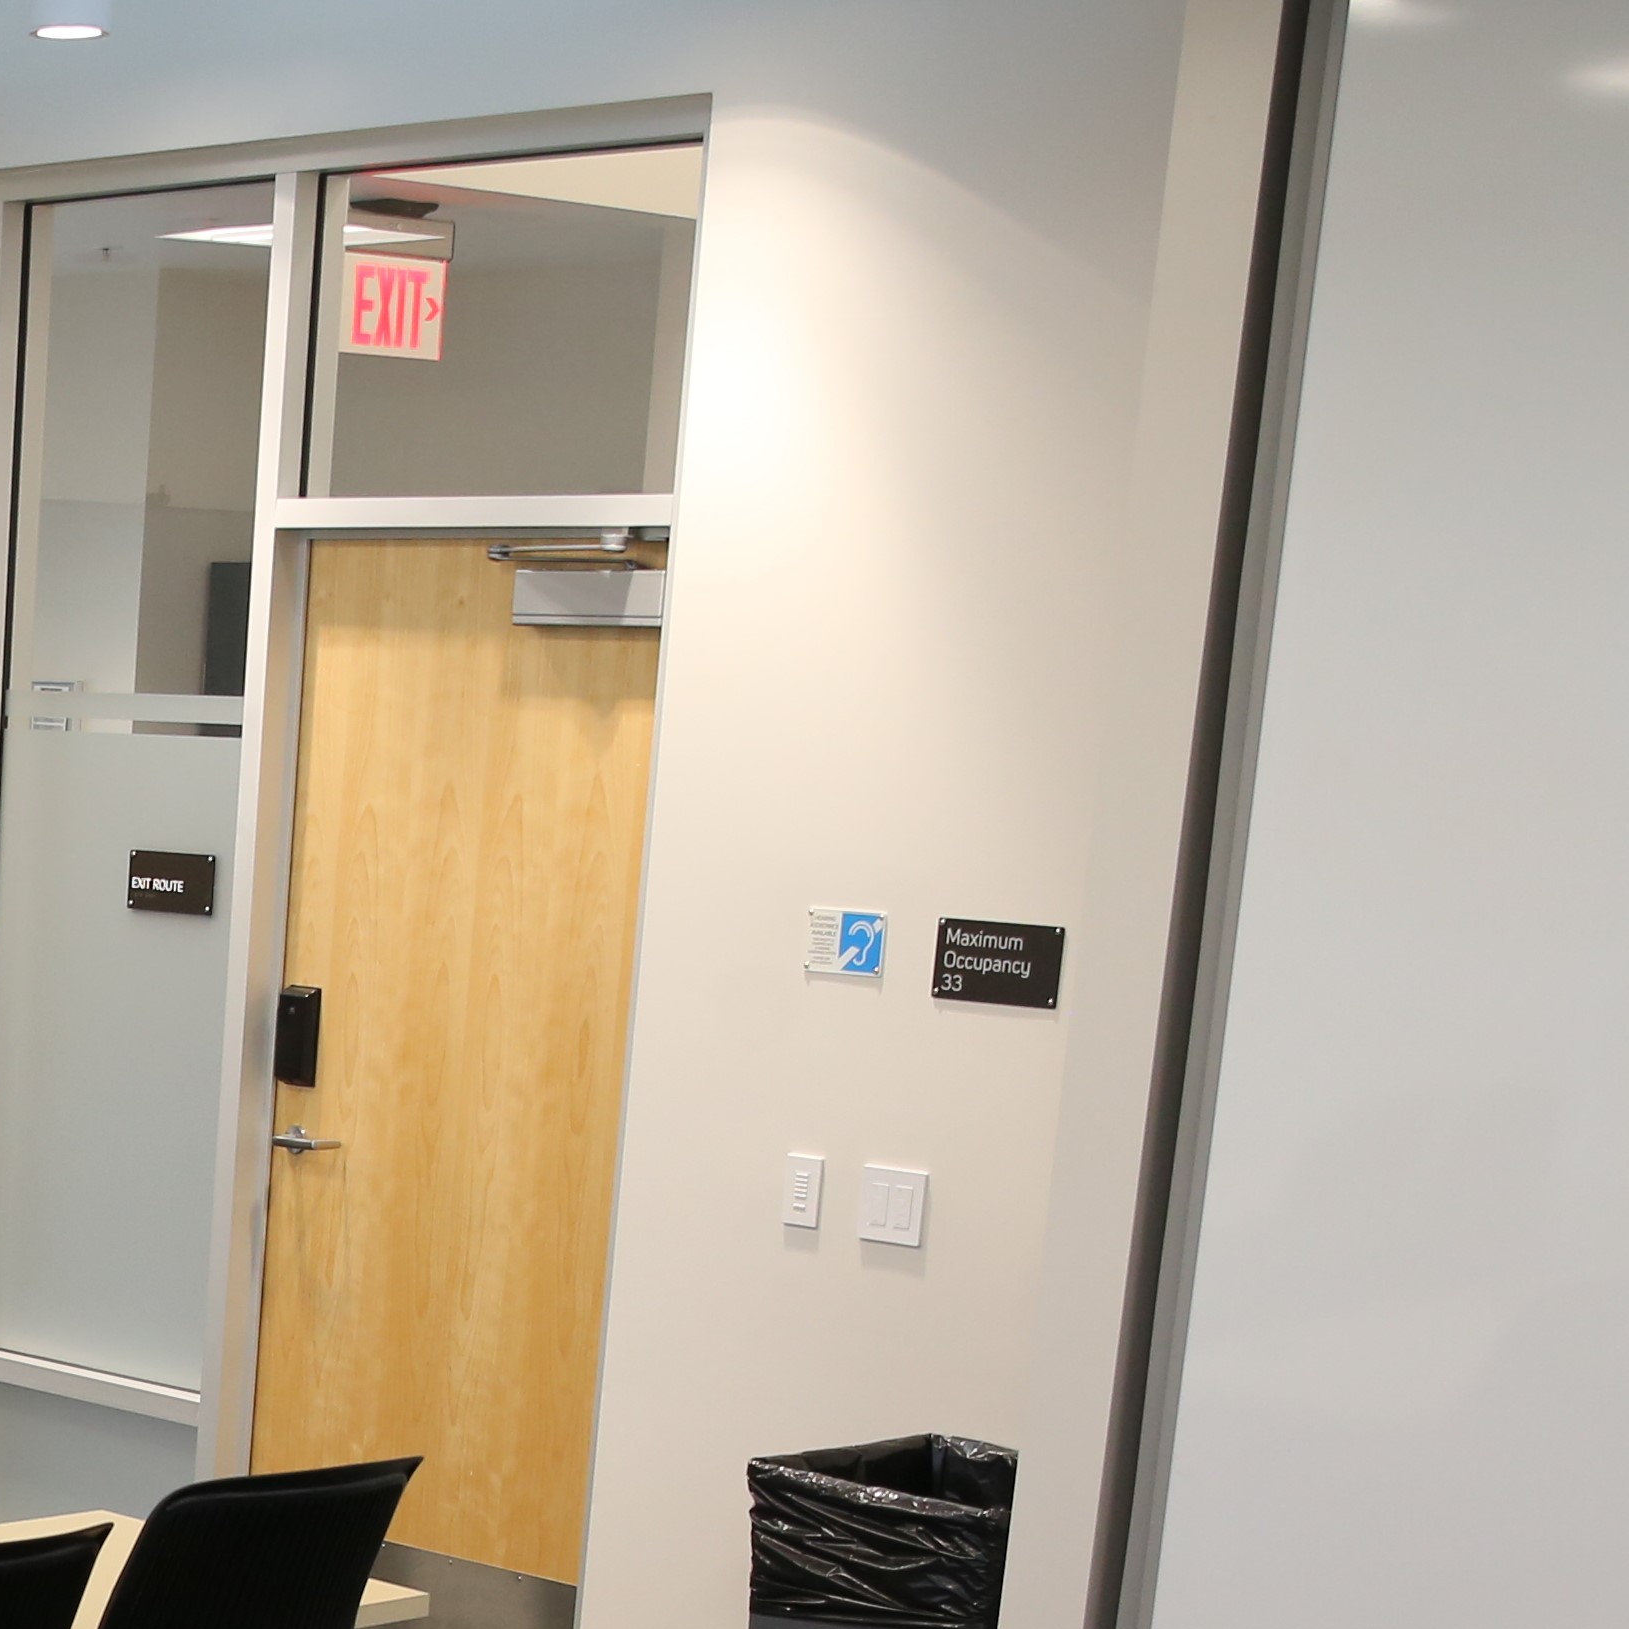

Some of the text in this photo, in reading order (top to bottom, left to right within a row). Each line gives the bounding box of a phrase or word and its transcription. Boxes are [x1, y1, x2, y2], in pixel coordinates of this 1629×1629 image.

[352, 264, 430, 349] EXIT
[131, 877, 184, 892] EXIT ROUTE
[945, 927, 1023, 951] Maximum
[943, 950, 1031, 979] Occupancy
[940, 974, 963, 992] 33
